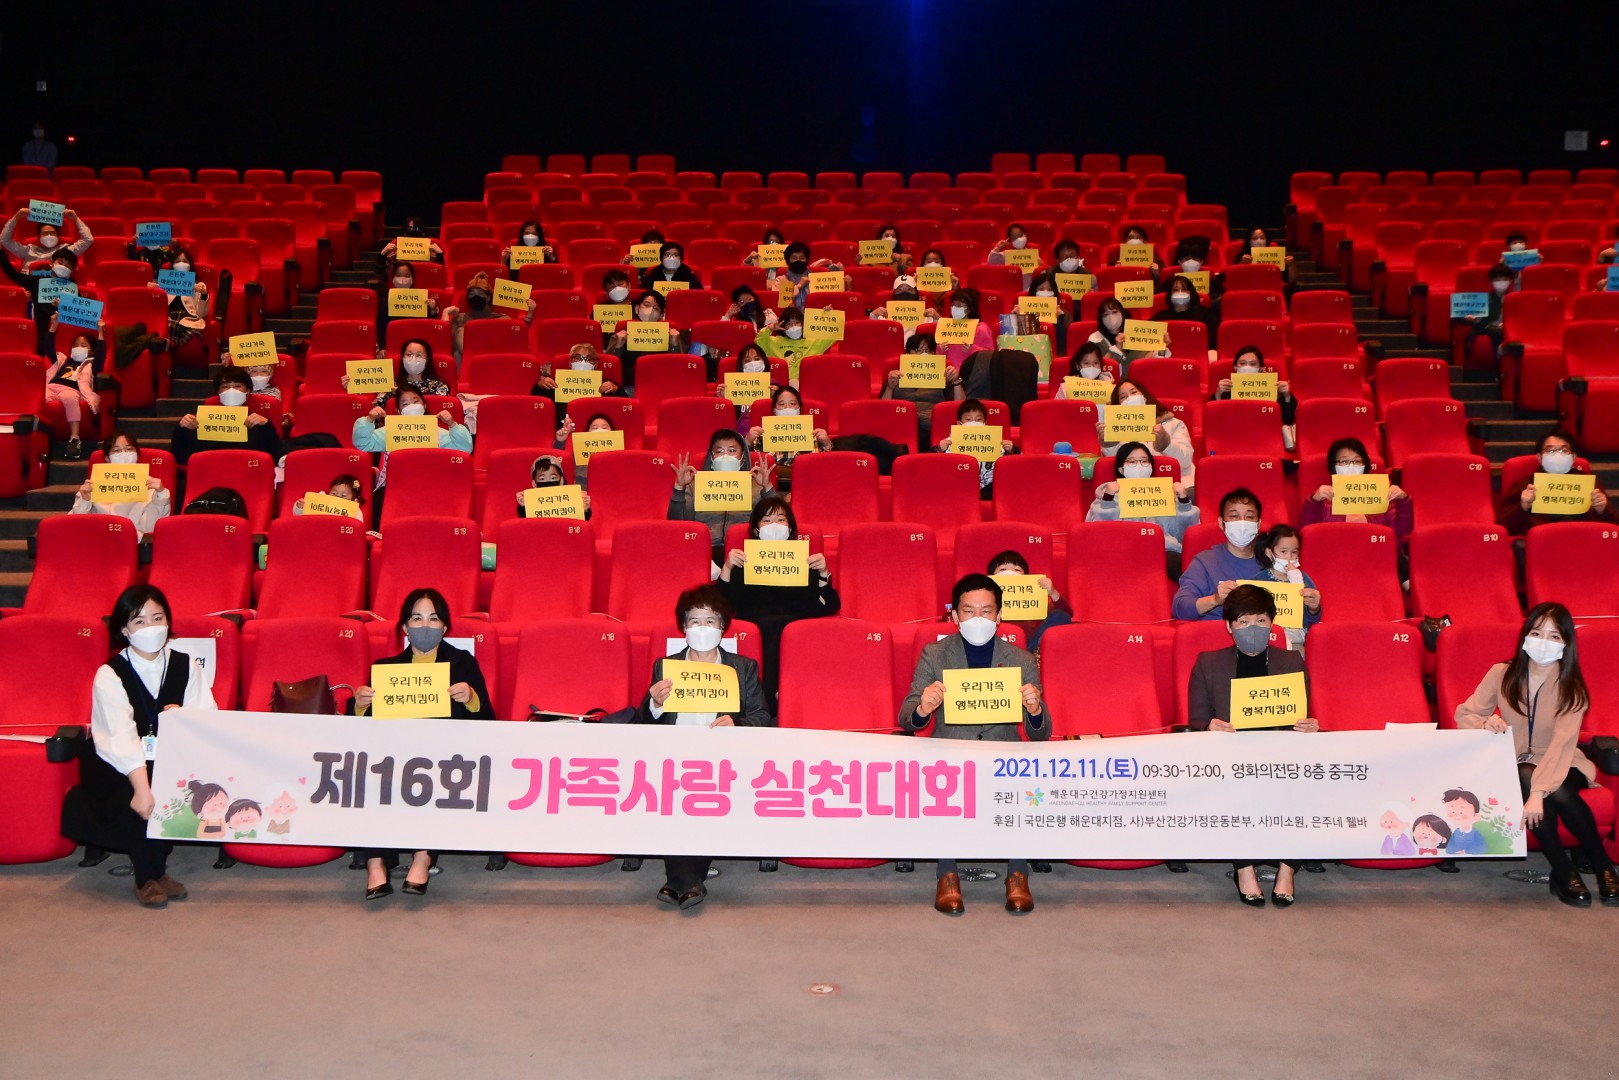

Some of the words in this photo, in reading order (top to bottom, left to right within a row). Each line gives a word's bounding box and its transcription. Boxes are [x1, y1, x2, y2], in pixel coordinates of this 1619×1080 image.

[240, 341, 264, 349] 우리가족
[204, 425, 239, 433] 행복지킴이
[770, 435, 806, 443] 행복지킴이
[99, 485, 139, 493] 행복지킴이
[1548, 483, 1580, 491] 우리가족
[538, 495, 569, 504] 우리가족
[1127, 499, 1166, 507] 행복지킴이
[1542, 496, 1584, 504] 행복지킴이
[535, 507, 575, 518] 행복지킴이
[759, 551, 794, 559] 우리가족
[754, 566, 799, 574] 행복지킴이
[1003, 599, 1039, 609] 복지킴이
[339, 630, 353, 638] A20
[473, 634, 484, 642] 19
[867, 633, 881, 641] A16
[1393, 633, 1408, 642] A12
[1128, 635, 1143, 643] A14
[681, 672, 721, 682] 우리가족
[390, 677, 432, 687] 우리가족
[961, 682, 1004, 692] 우리가족
[675, 689, 728, 698] 행복지킴이
[1249, 688, 1290, 699] 우리가족
[384, 694, 438, 705] 행복지킴이
[956, 699, 1010, 710] 행복지킴이
[1242, 704, 1296, 716] 행복지킴이
[993, 757, 1139, 781] 2021.12.11.(토)
[1143, 764, 1225, 779] 09:30-12:00,
[1232, 763, 1300, 779] 영화의전당
[1304, 764, 1325, 780] 8층
[1329, 764, 1369, 780] 중극장
[311, 751, 491, 812] 제16회
[508, 757, 737, 816] 가족사랑
[750, 759, 976, 819] 실천대회
[993, 792, 1014, 804] 주관
[1050, 789, 1167, 799] 해운대구건강가정지원센터
[993, 814, 1014, 827] 후원
[1024, 815, 1066, 828] 국민은행
[1070, 815, 1127, 828] 해운대지점,
[1130, 815, 1255, 828] 사)부산건강가정운동본부,
[1259, 816, 1308, 828] 사)미소원,
[1312, 816, 1343, 828] 은주네
